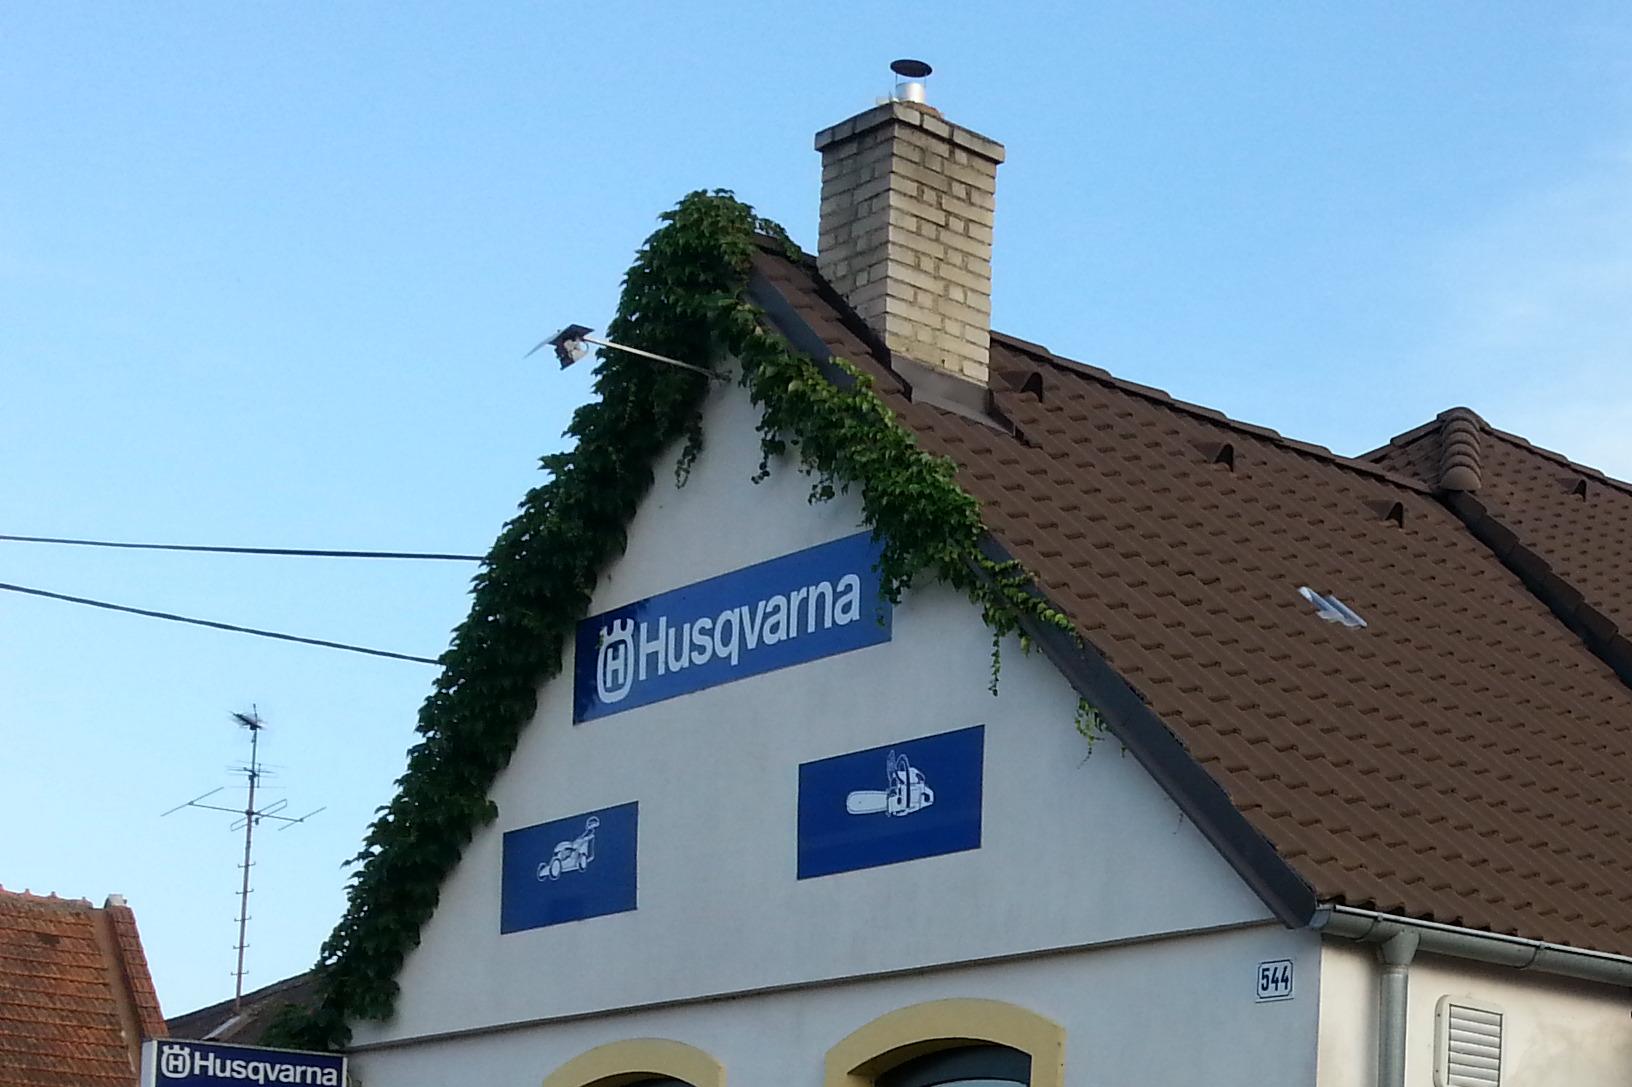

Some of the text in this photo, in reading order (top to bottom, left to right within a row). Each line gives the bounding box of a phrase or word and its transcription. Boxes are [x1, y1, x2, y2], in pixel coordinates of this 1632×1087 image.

[638, 573, 861, 681] Husqvarna
[1261, 965, 1290, 991] 544
[193, 1052, 338, 1087] Husqvarna
